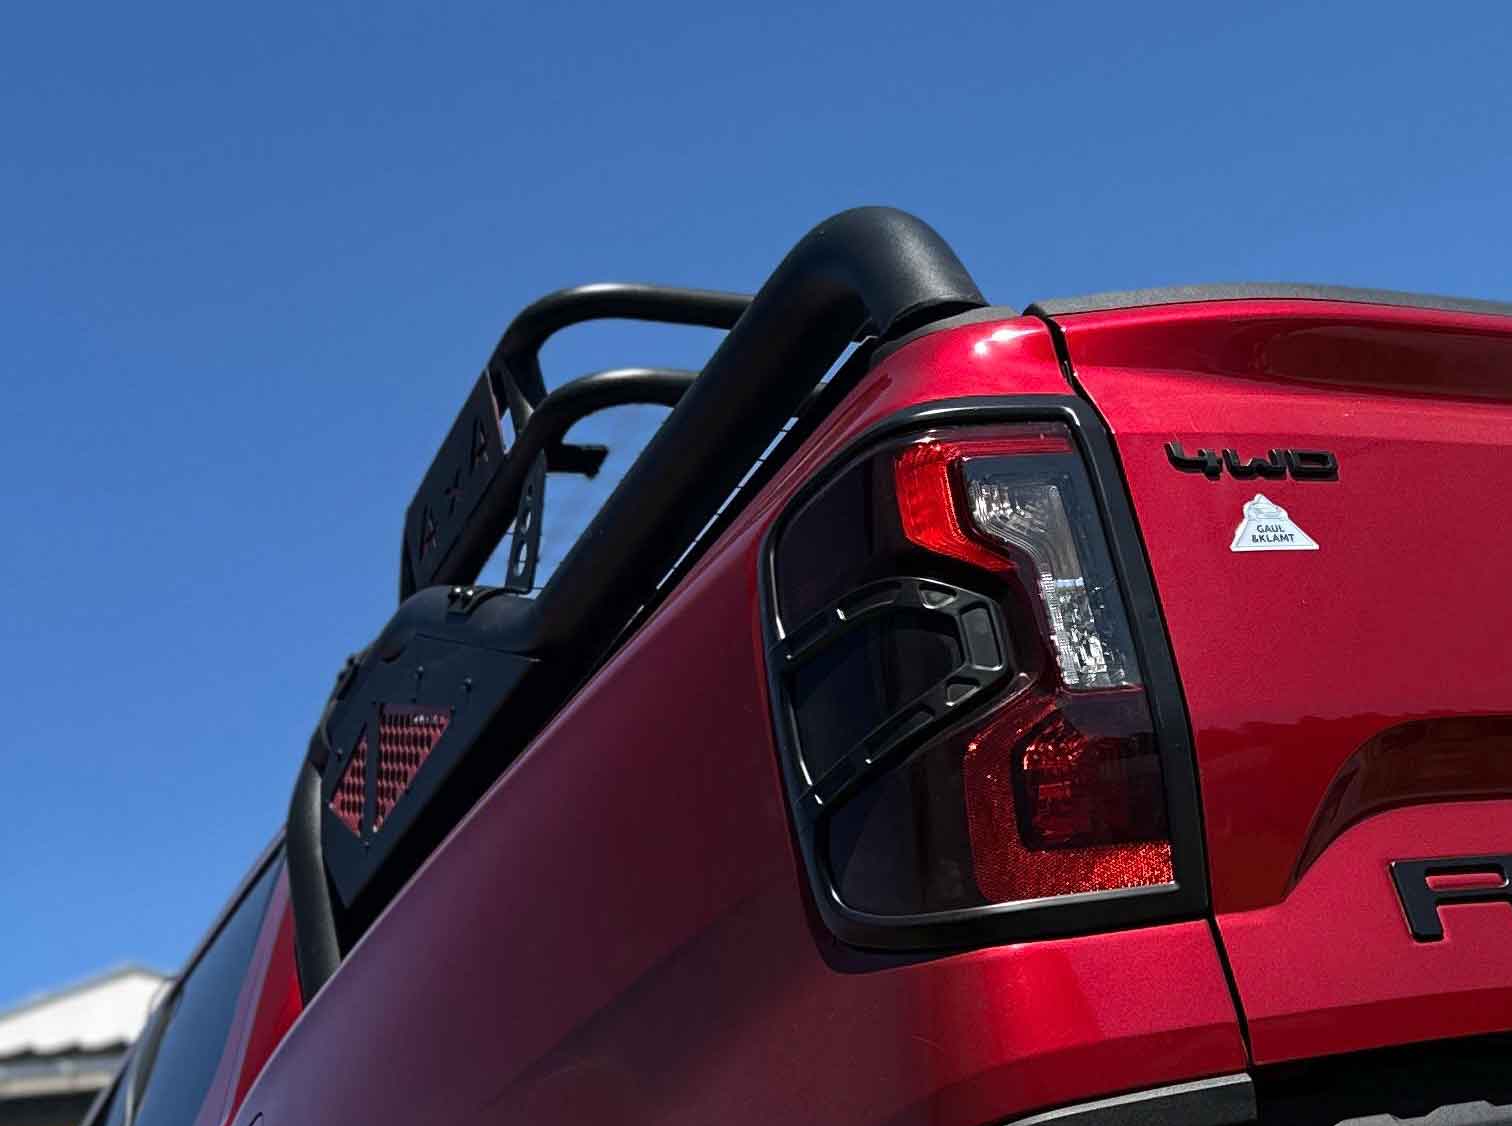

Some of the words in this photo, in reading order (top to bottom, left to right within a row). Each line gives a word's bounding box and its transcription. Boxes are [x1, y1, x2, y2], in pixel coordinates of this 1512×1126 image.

[1164, 440, 1339, 481] 4WD
[1256, 524, 1285, 533] GAUL
[1251, 533, 1295, 543] &KLAMT
